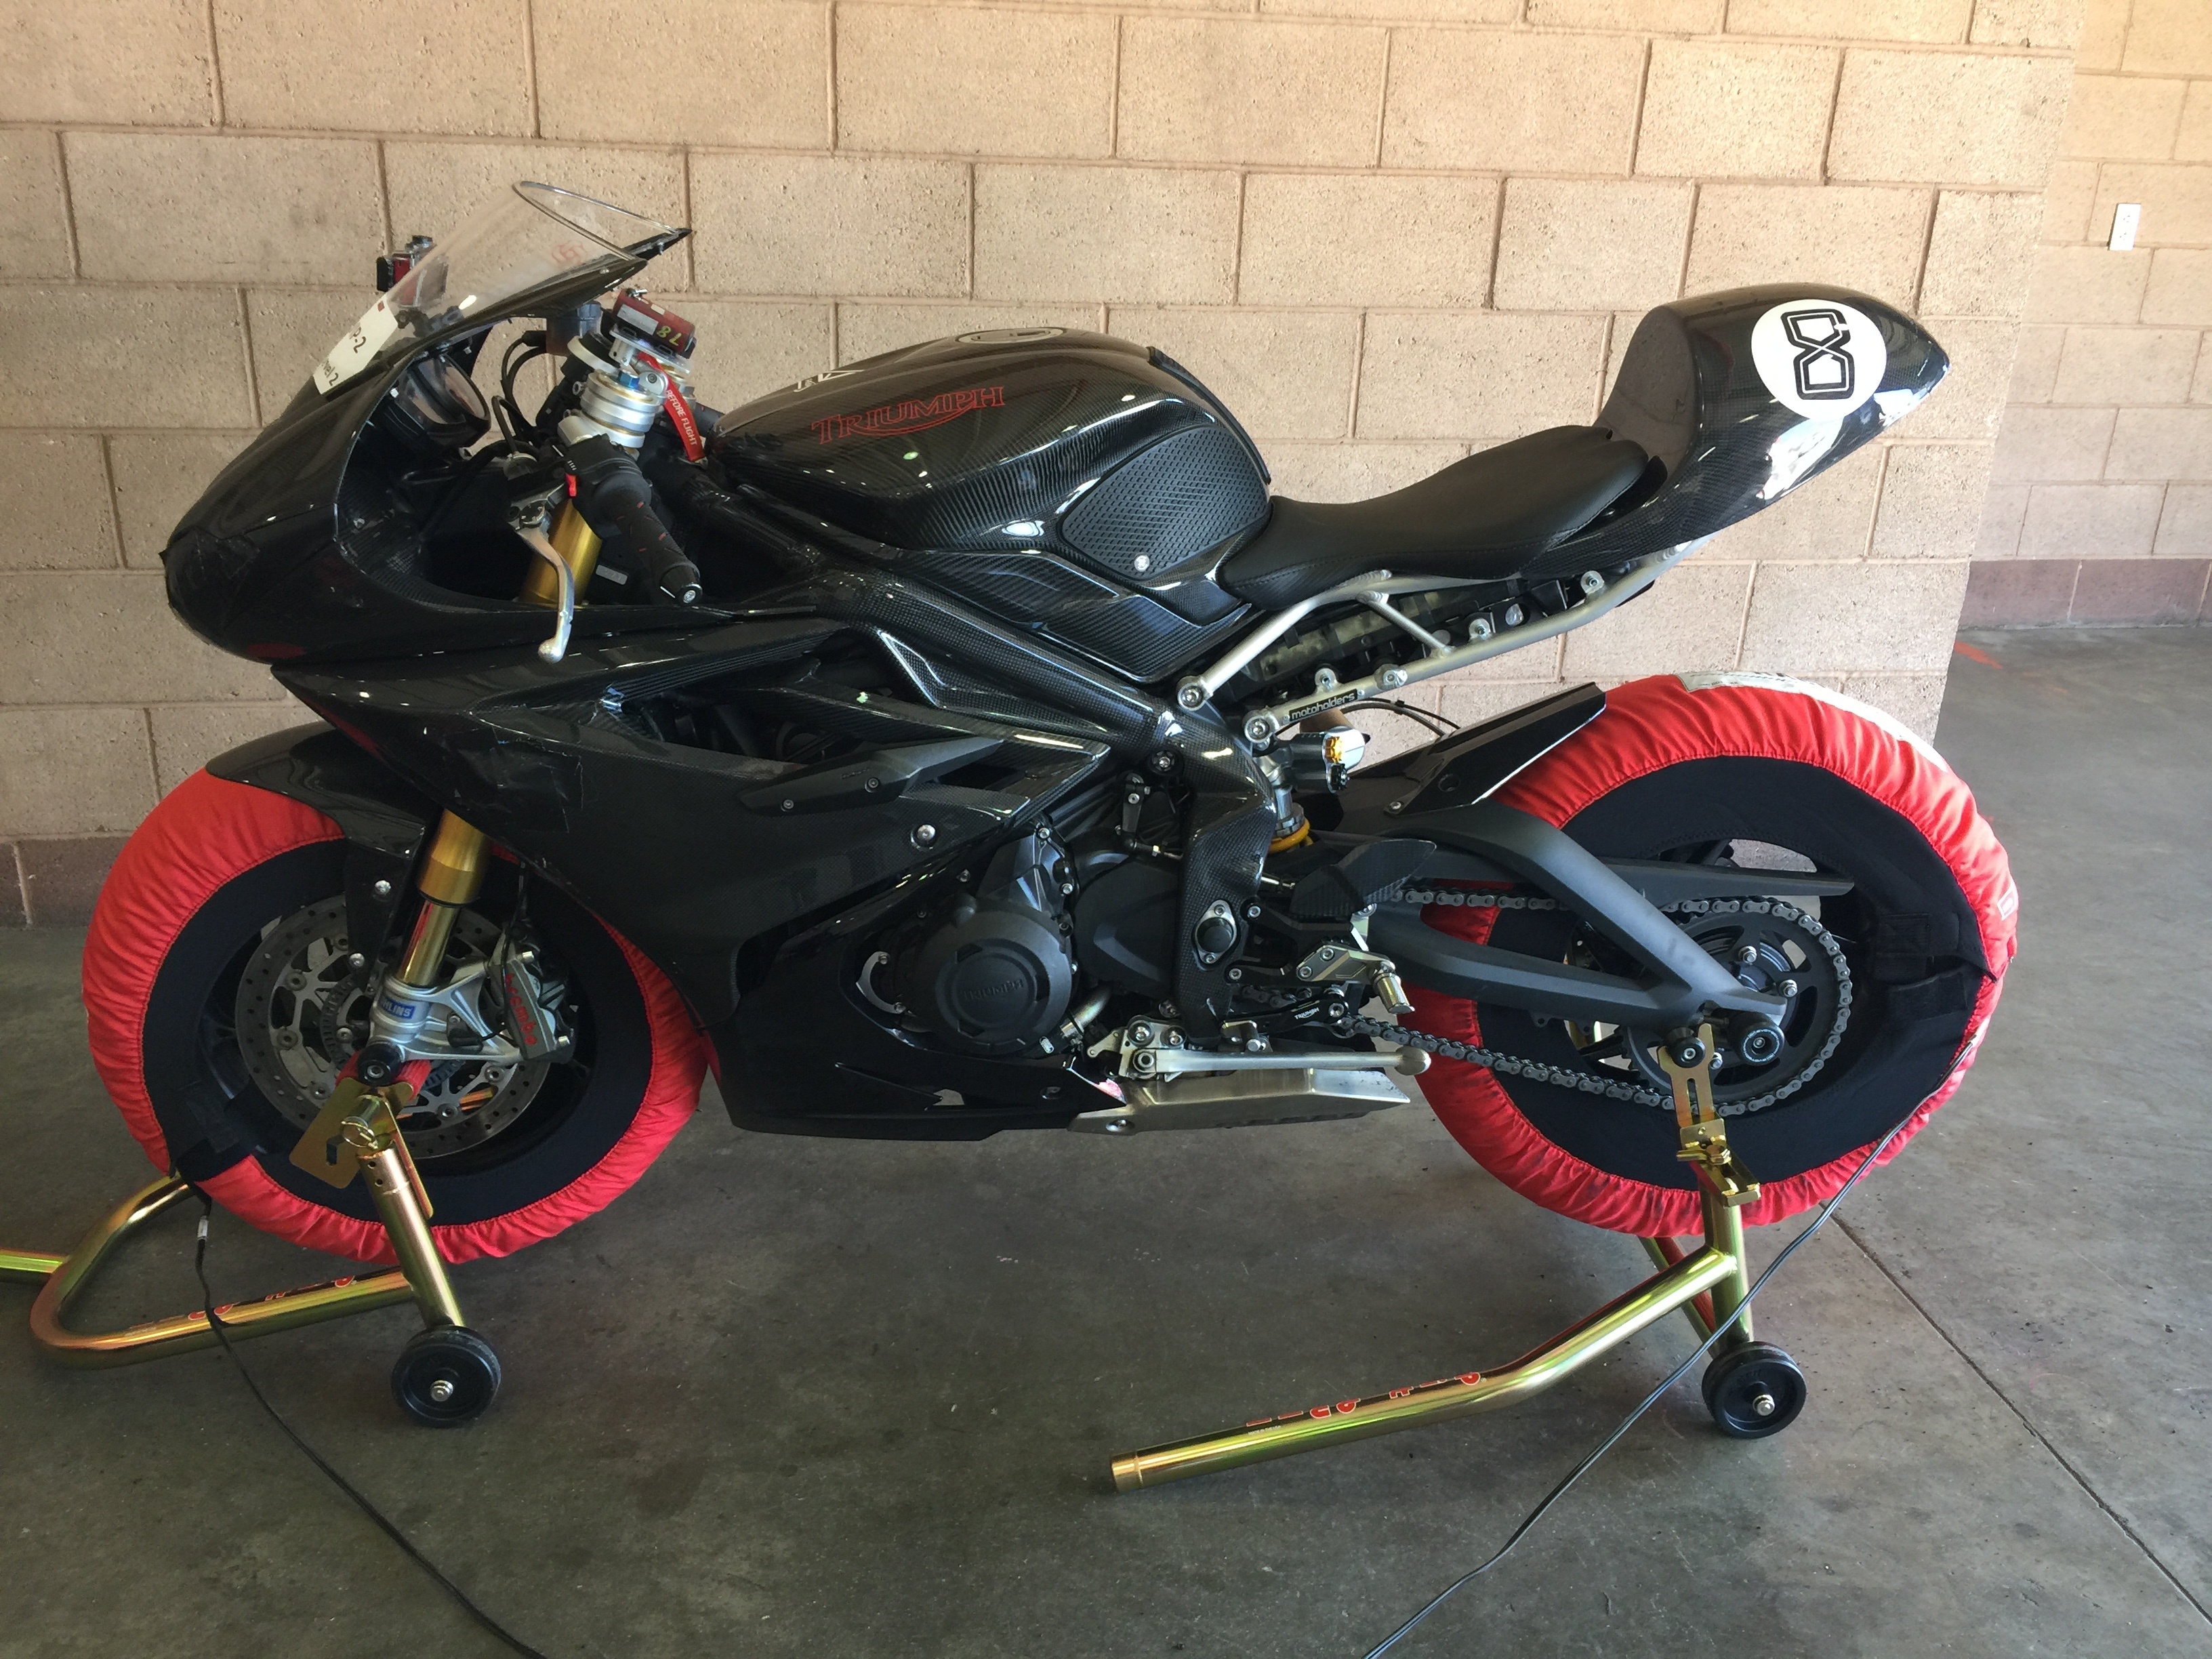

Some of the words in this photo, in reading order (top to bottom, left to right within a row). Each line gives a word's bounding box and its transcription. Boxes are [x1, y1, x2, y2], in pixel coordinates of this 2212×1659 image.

[665, 390, 686, 417] BEFORE
[681, 416, 698, 446] FLIGHT
[811, 386, 1006, 445] TRIUMPH
[1291, 691, 1355, 720] motoholders
